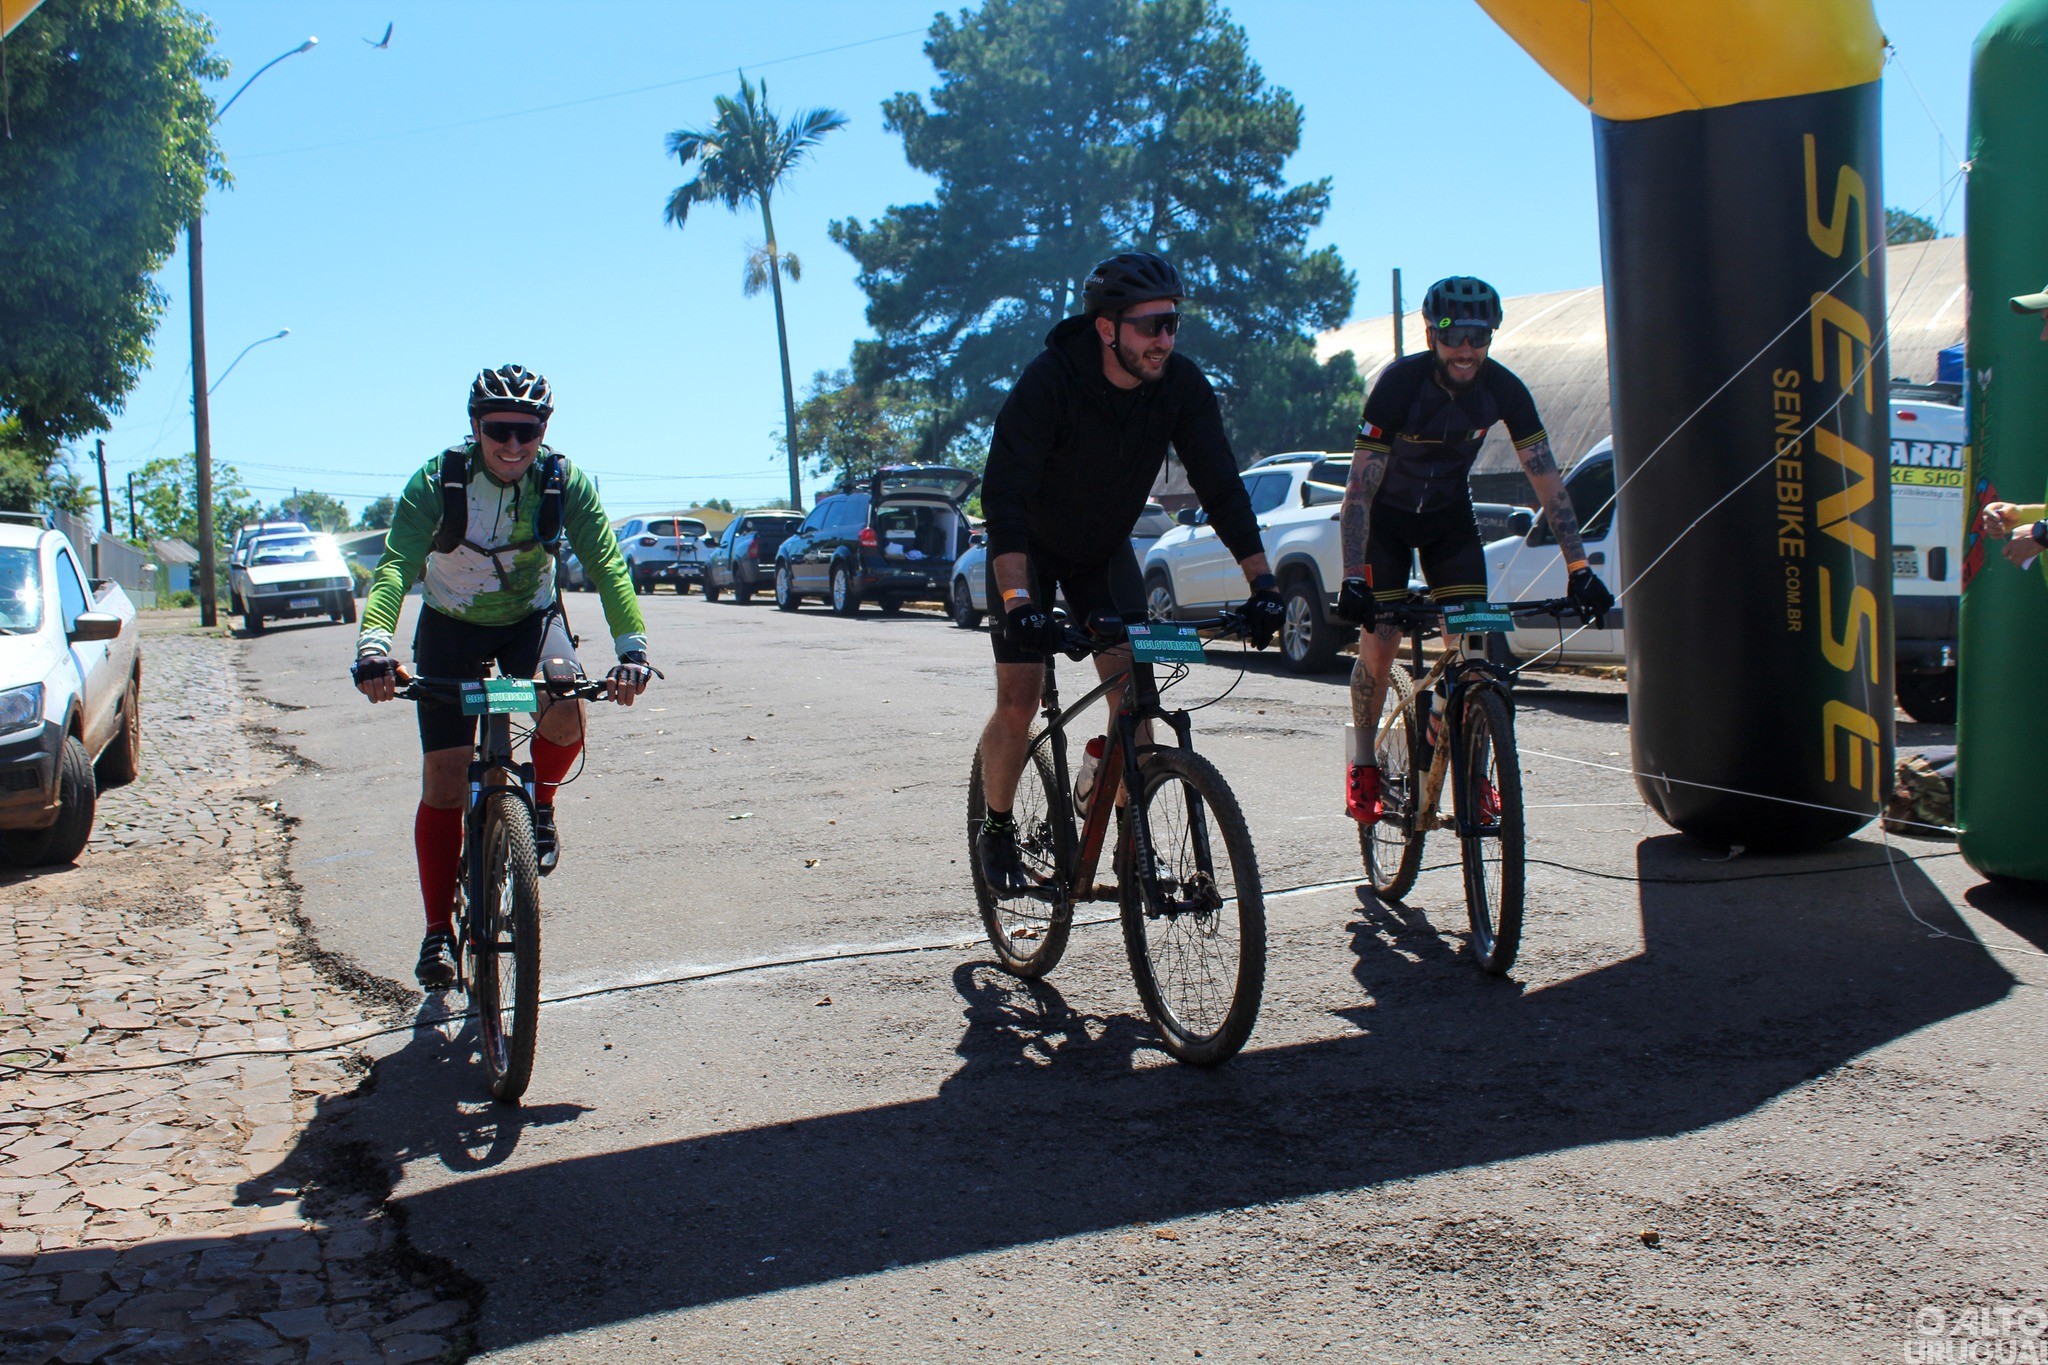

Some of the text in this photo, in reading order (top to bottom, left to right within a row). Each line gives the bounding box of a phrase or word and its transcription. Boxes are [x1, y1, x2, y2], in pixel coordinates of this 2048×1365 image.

[1803, 133, 1880, 803] SENSE
[1134, 639, 1200, 652] CICLOTURISMO
[466, 692, 533, 703] CICLOTURISMO
